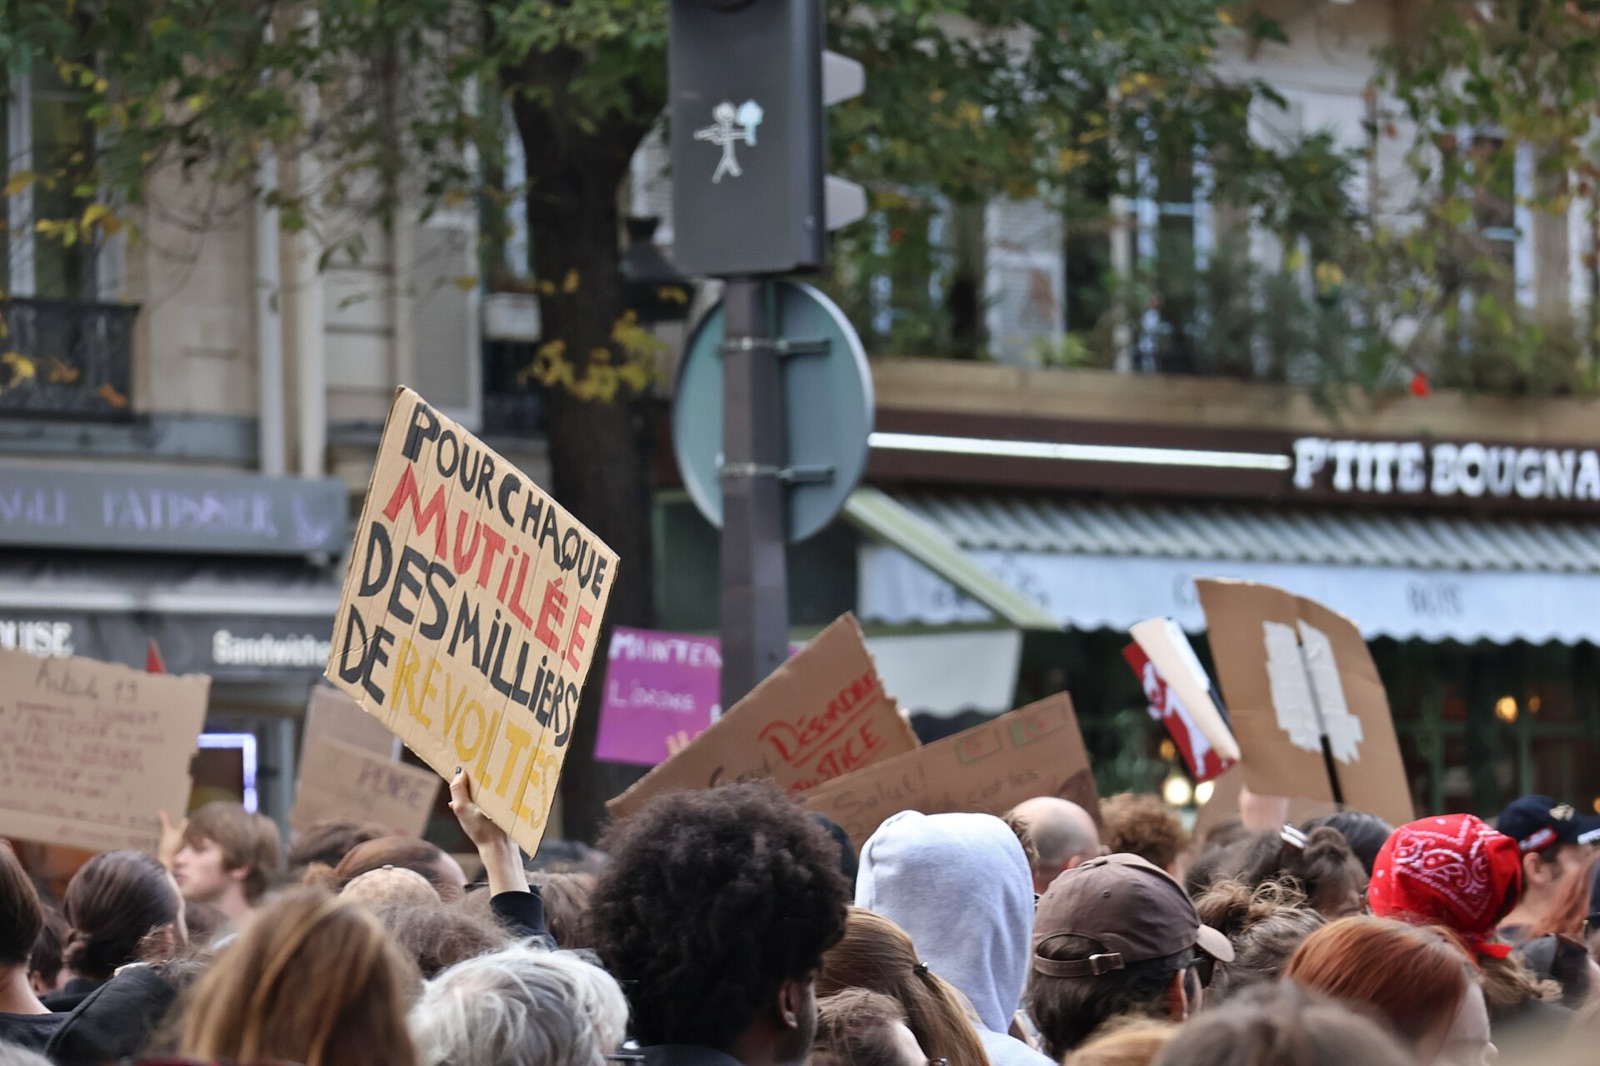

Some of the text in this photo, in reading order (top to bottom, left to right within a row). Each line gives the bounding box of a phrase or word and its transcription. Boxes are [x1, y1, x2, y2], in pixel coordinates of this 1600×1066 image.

[401, 401, 608, 600] POUR CHAQUE
[357, 520, 456, 642] DES
[339, 603, 395, 706] DE
